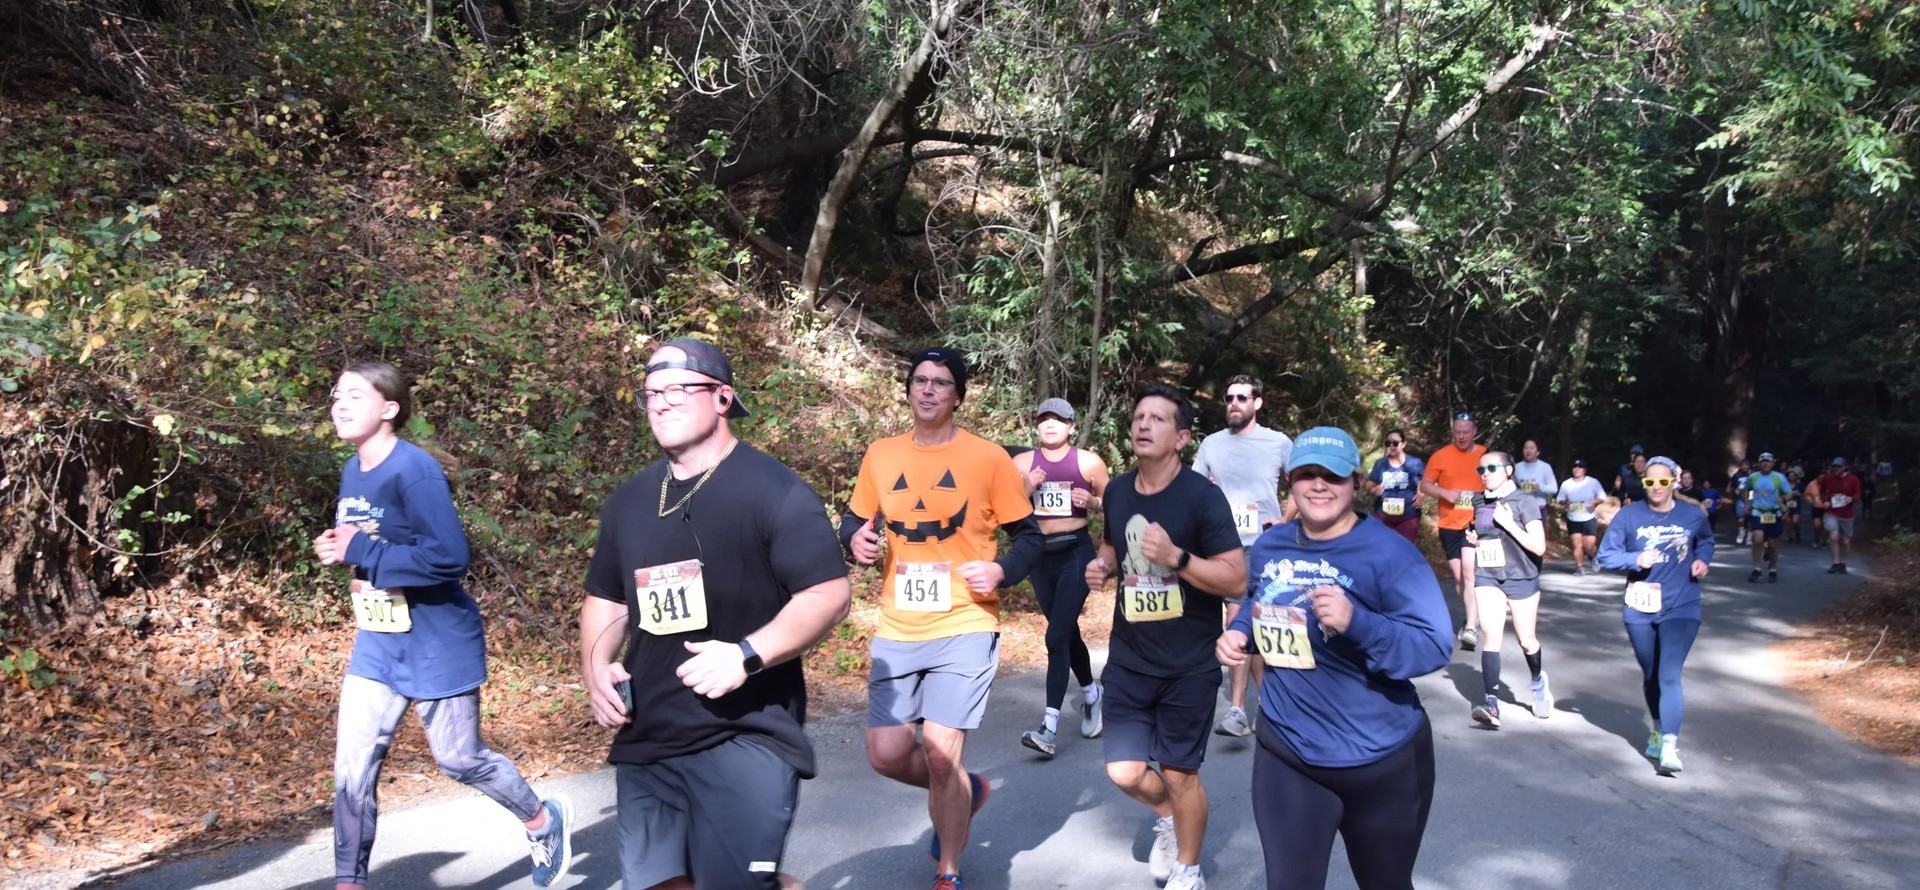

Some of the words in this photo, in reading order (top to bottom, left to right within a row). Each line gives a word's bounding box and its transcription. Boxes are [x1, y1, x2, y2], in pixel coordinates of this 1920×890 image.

[1040, 492, 1063, 507] 135
[1235, 514, 1250, 528] 34
[904, 578, 939, 602] 454
[648, 586, 691, 623] 341
[1135, 591, 1170, 613] 587
[1260, 625, 1299, 656] 572
